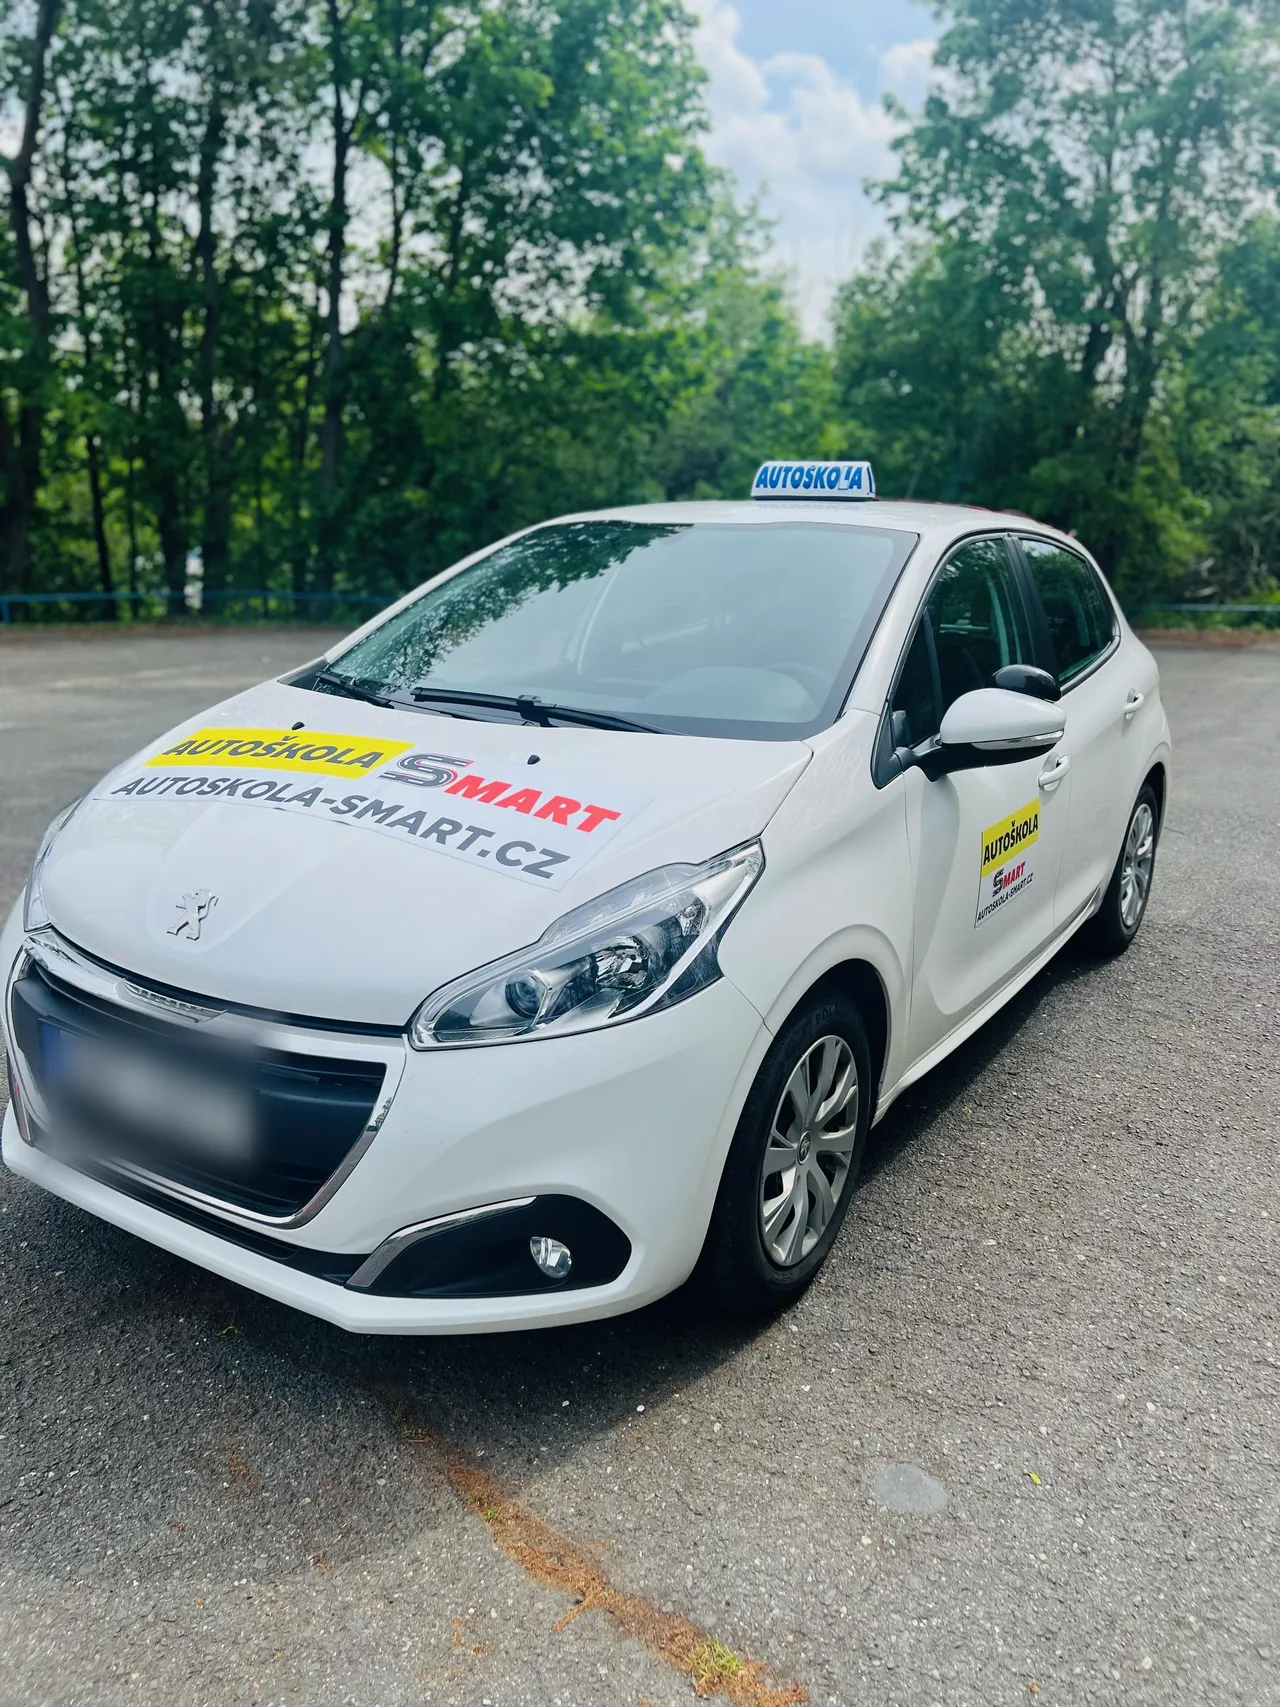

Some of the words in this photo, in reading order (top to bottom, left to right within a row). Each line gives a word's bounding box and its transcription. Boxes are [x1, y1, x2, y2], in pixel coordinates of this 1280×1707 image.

[162, 735, 385, 769] AUTOŠKOLA
[378, 753, 622, 833] SMART
[110, 777, 571, 880] AUTOSKOLA-SMART.CZ
[983, 813, 1039, 866] AUTOŠKOLA
[977, 872, 1034, 922] AUTOSKOLA-SMART.CZ
[992, 861, 1026, 898] SMART
